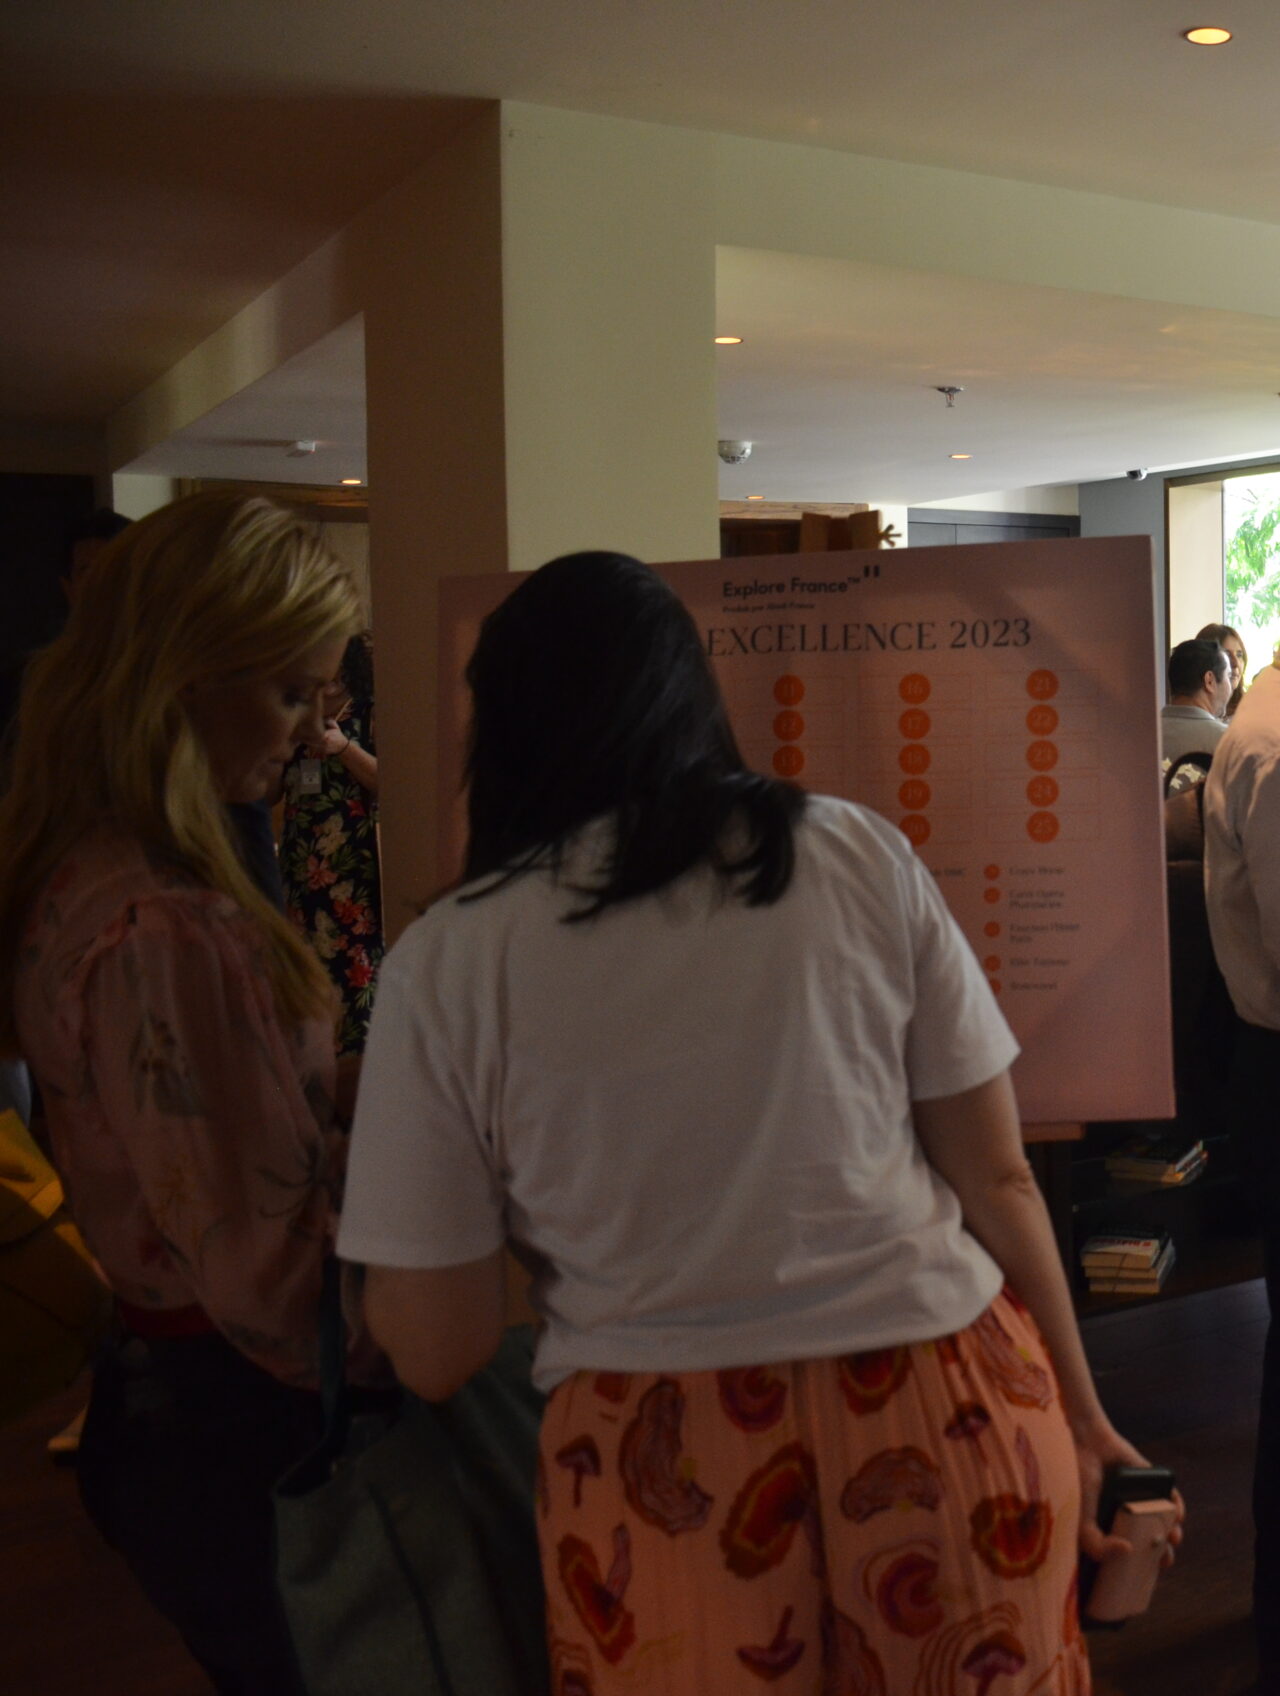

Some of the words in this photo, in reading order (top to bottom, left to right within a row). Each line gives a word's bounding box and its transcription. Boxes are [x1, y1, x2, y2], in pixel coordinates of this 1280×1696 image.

[722, 579, 786, 600] Explore
[706, 622, 938, 657] EXCELLENCE
[949, 618, 1032, 649] 2023
